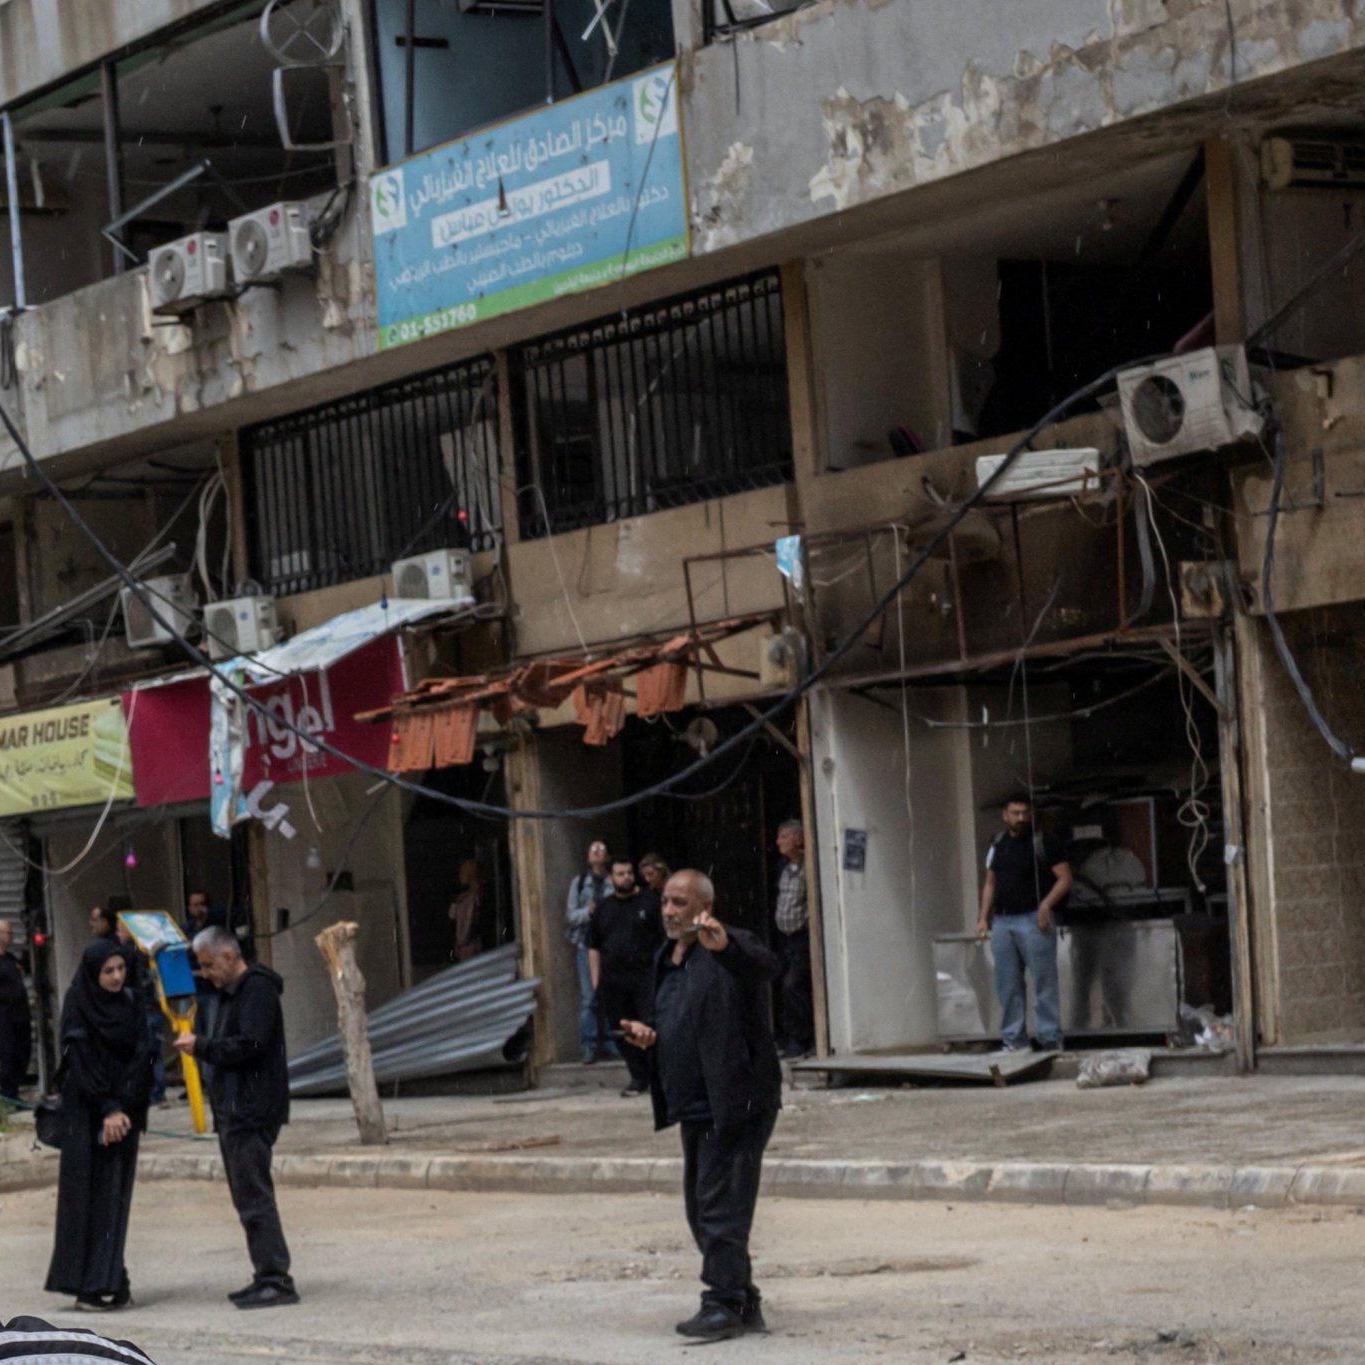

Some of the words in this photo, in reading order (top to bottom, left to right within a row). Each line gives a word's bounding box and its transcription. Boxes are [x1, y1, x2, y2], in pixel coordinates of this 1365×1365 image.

[523, 121, 582, 172] الصادق
[587, 113, 627, 150] مركز
[536, 166, 599, 211] الدكتور
[32, 713, 91, 746] HOUSE
